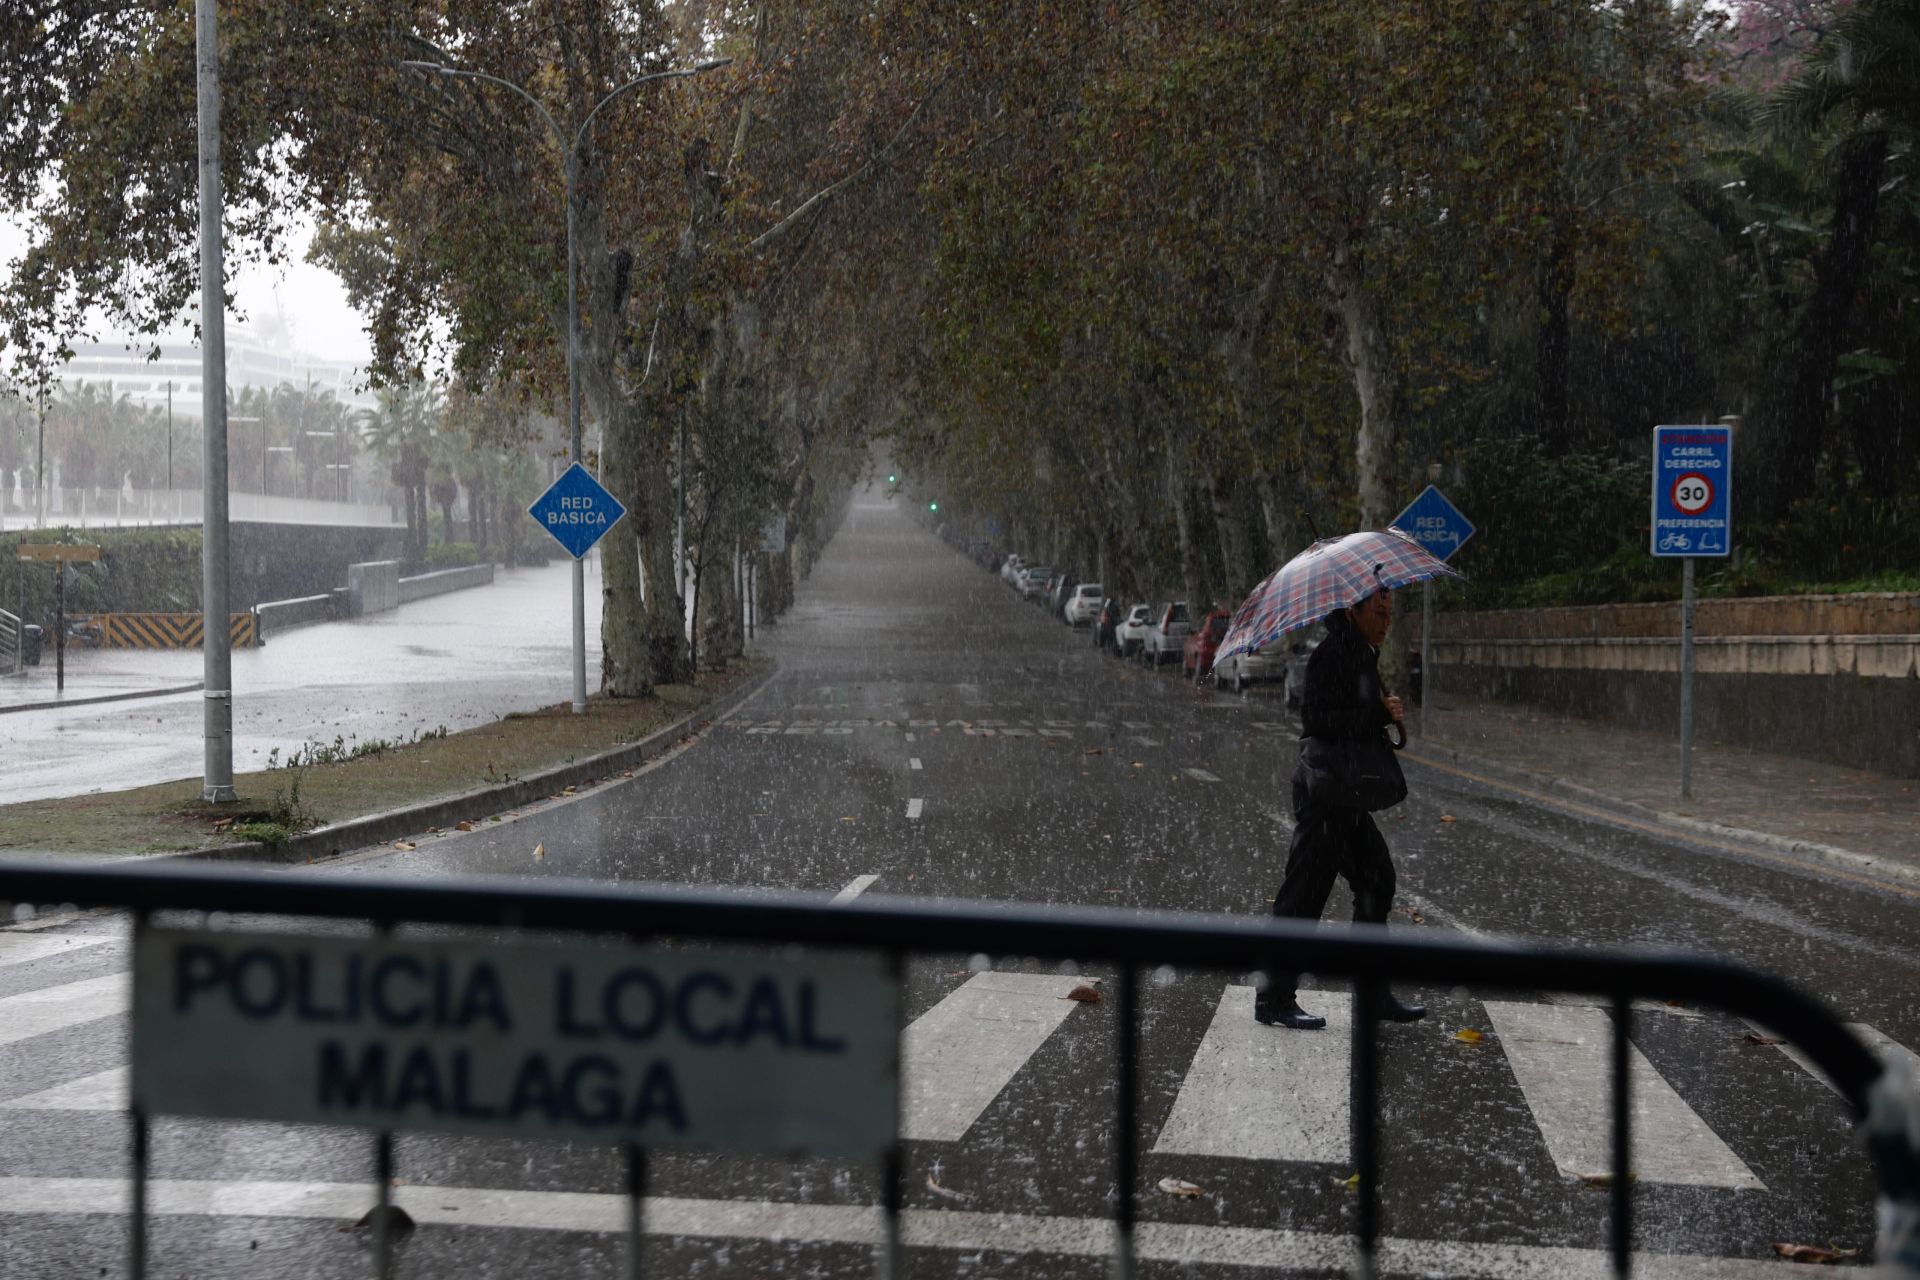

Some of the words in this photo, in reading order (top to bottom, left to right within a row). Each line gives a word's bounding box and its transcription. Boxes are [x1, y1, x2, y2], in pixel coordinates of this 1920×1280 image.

[1671, 447, 1714, 457] CARRIL
[1665, 459, 1721, 469] DERECHO
[1680, 487, 1704, 501] 30
[561, 497, 592, 509] RED
[547, 512, 606, 524] BASICA
[1416, 517, 1446, 528] RED
[1658, 519, 1725, 528] PREFERENCIA
[173, 945, 514, 1033] POLICIA
[553, 962, 848, 1053] LOCAL
[315, 1040, 689, 1134] MALAGA
